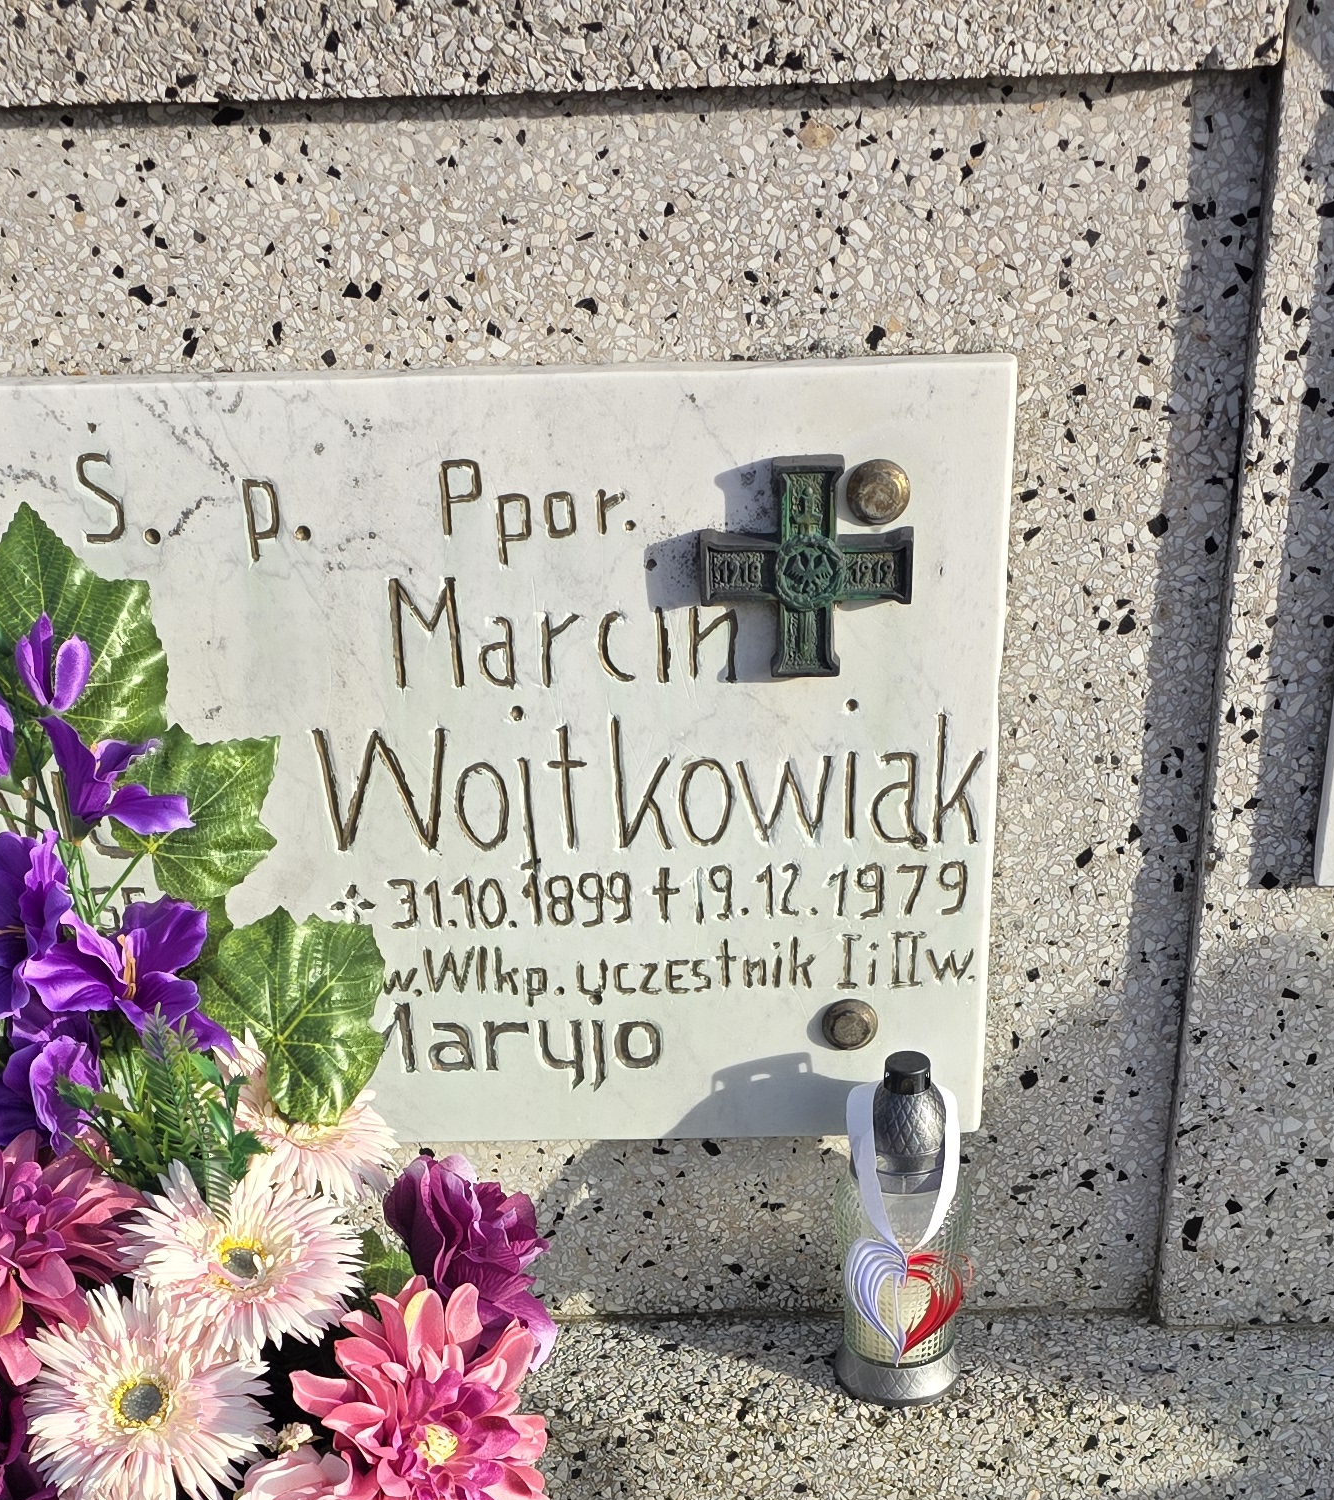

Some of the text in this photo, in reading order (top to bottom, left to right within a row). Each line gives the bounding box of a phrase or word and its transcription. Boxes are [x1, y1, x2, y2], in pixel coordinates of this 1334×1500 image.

[241, 478, 312, 562] p.
[439, 458, 637, 567] Ppor.
[719, 559, 763, 584] 1918
[387, 558, 737, 689] Marcin
[312, 699, 985, 870] Wojtkowiak
[387, 860, 969, 930] 31.10.1899 19.12.1979
